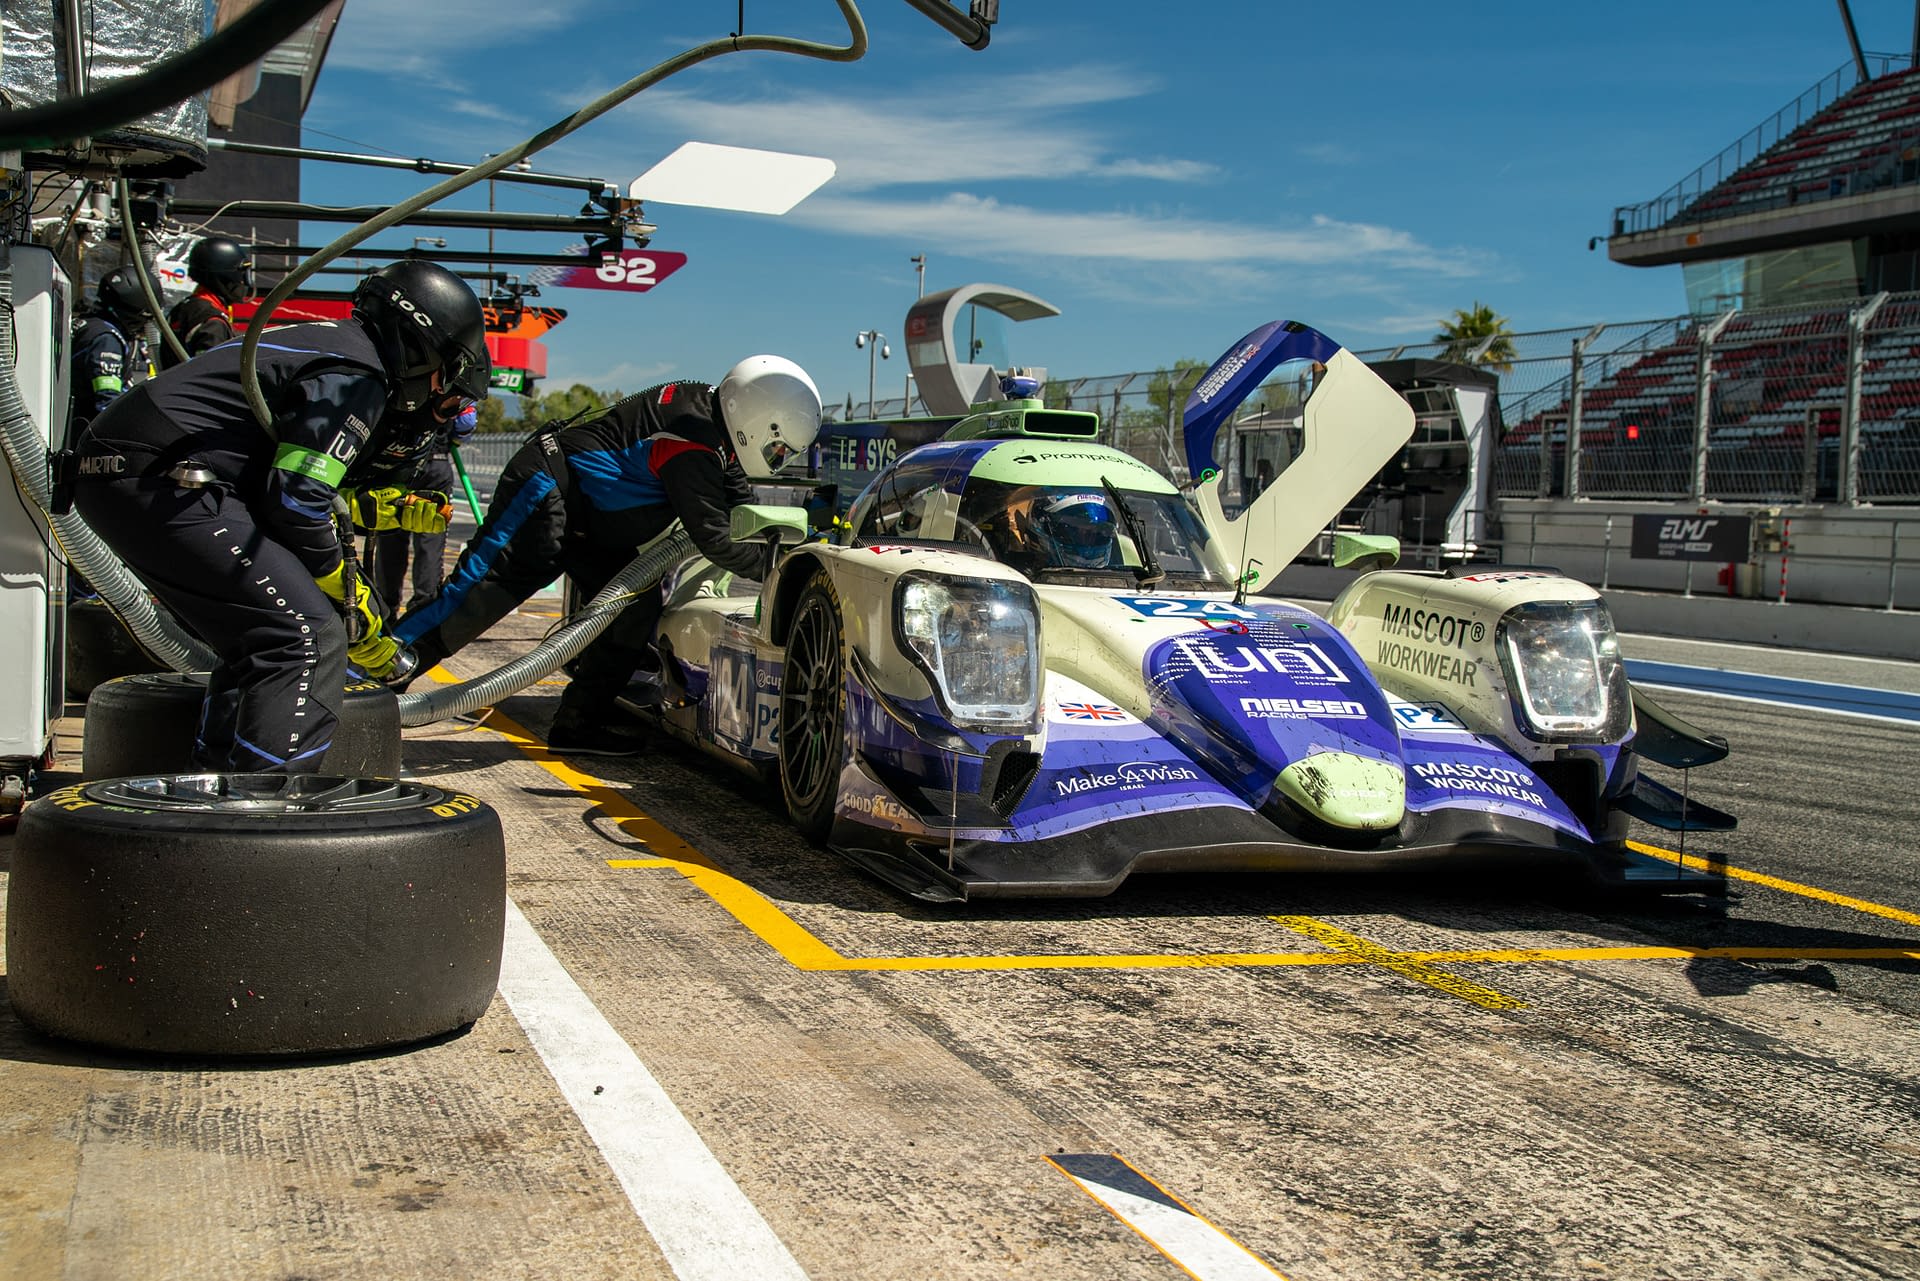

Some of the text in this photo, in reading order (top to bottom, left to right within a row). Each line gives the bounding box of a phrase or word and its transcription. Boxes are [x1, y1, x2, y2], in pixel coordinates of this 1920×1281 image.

[596, 255, 656, 285] 62
[1202, 358, 1247, 403] PEARSON
[839, 438, 897, 471] LEASYS
[1040, 452, 1152, 473] PromptShop
[1660, 519, 1718, 540] ELMS
[1134, 599, 1257, 618] 24
[1378, 640, 1478, 688] WORKWEAR
[1239, 698, 1368, 715] NIELSEN
[1247, 711, 1308, 720] RACING
[1394, 707, 1454, 723] P2
[758, 703, 780, 743] P2
[1056, 762, 1199, 796] Make-A-Wish
[1119, 783, 1146, 791] ISRAEL
[1425, 778, 1548, 808] WORKWEAR
